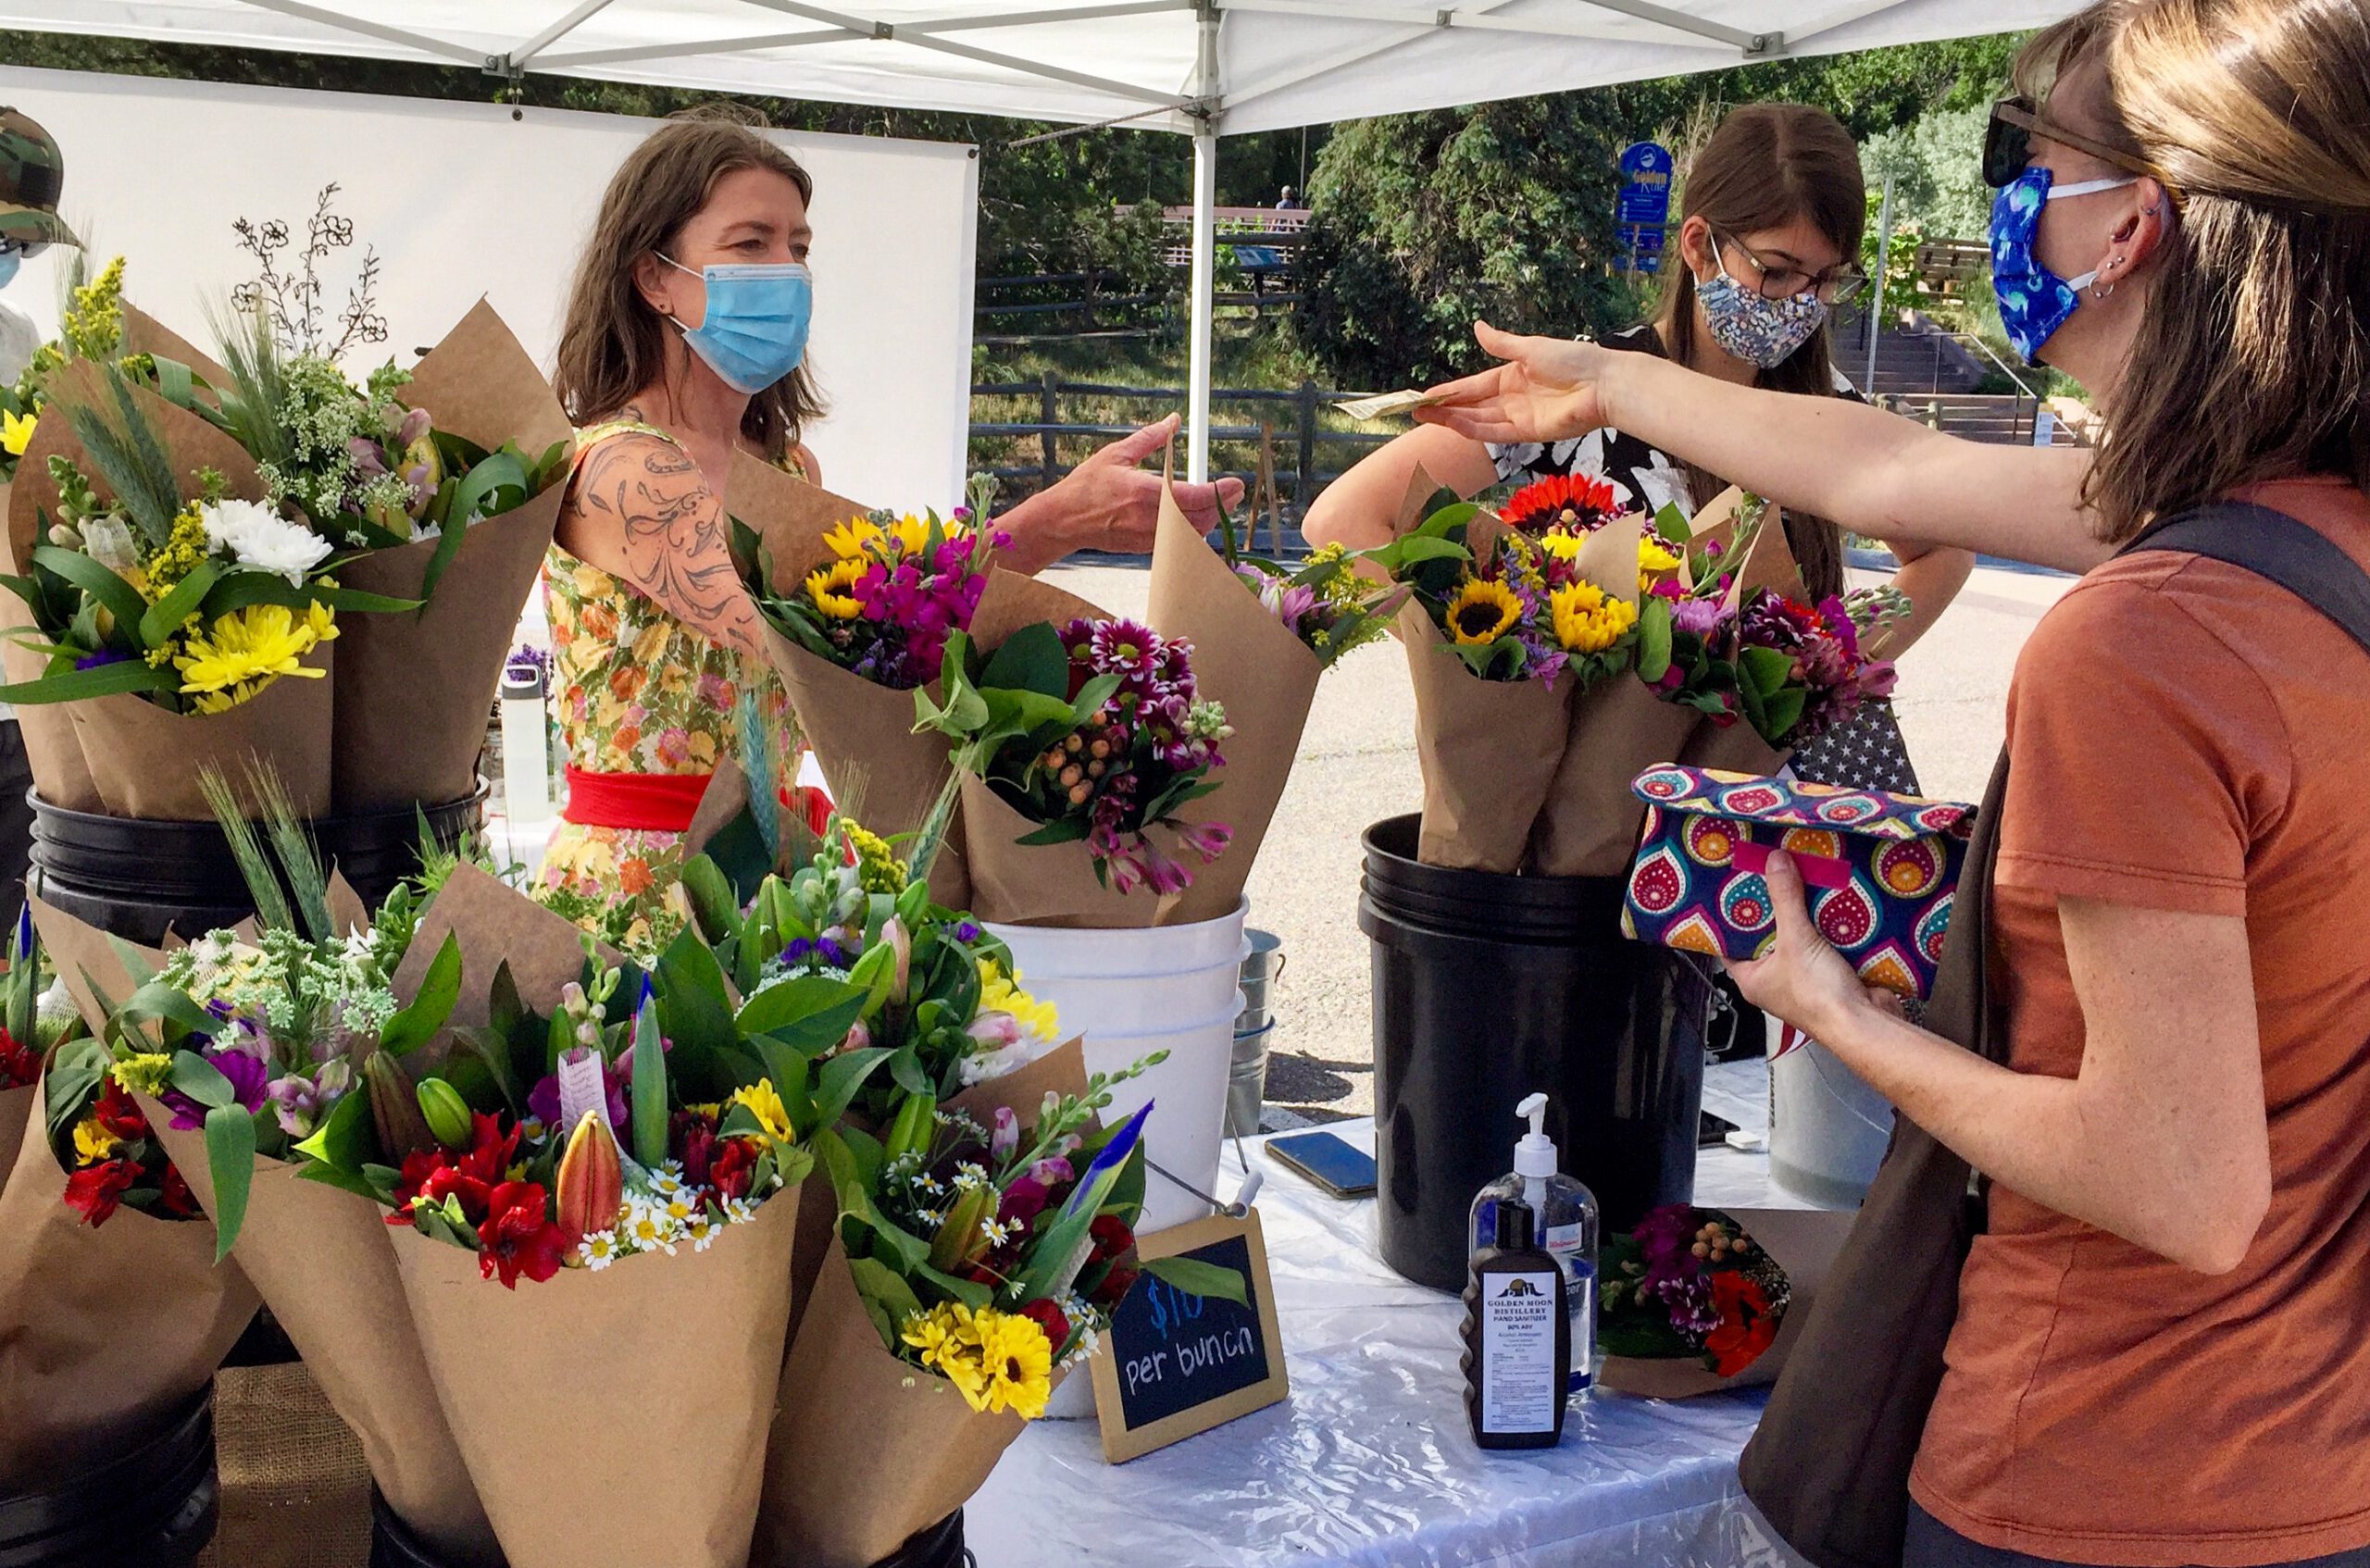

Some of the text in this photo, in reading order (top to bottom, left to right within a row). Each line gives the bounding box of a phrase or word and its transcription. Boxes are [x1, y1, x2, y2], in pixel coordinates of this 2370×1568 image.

[1633, 168, 1667, 185] Golden
[1640, 181, 1665, 193] Rule
[1148, 1278, 1203, 1339] $10
[1126, 1325, 1254, 1396] per bunch
